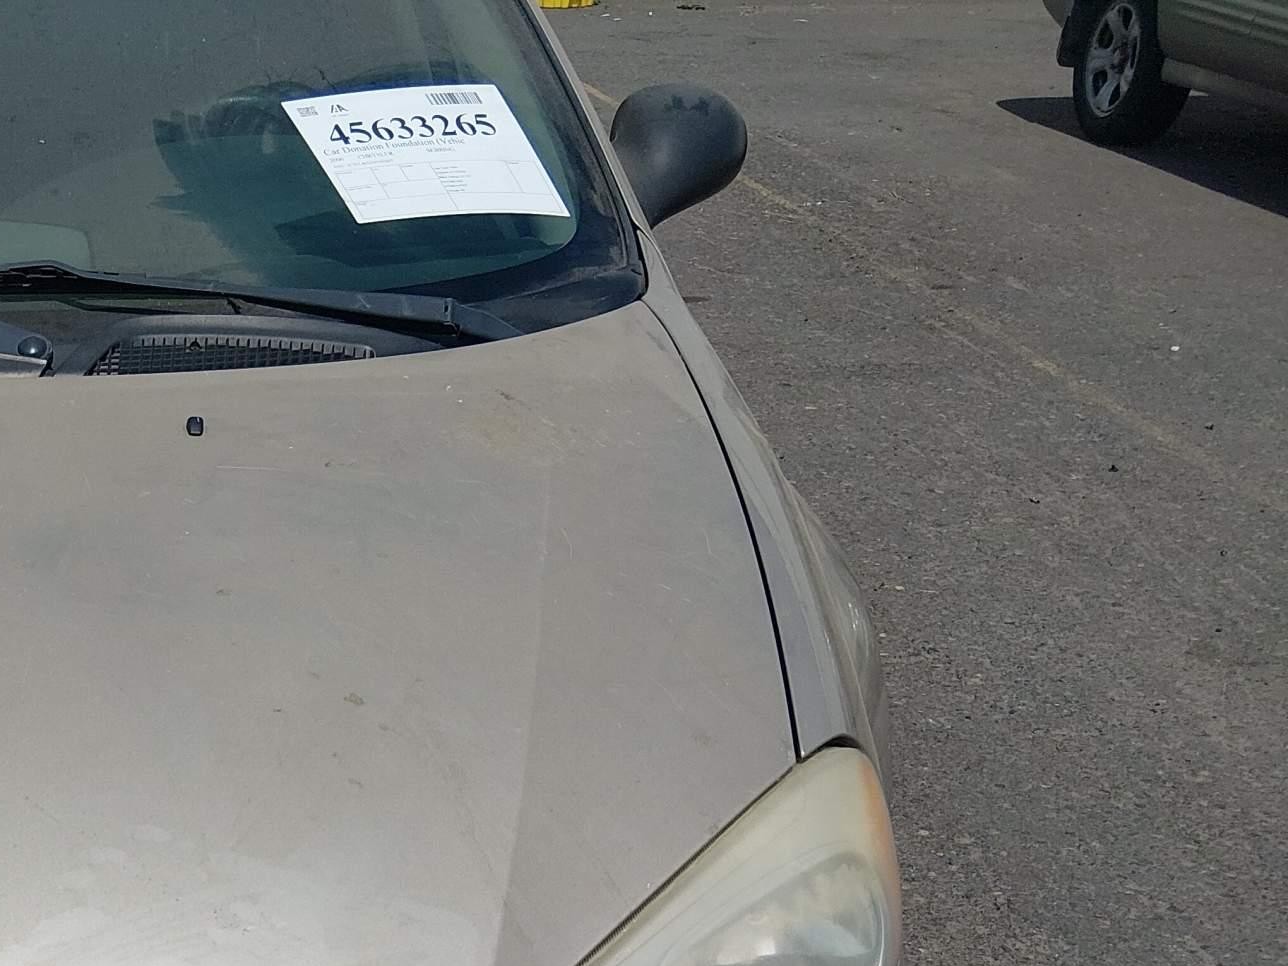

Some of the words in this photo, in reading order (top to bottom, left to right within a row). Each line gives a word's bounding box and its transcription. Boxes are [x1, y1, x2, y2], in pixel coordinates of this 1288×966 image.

[330, 114, 497, 145] 45633265
[323, 148, 340, 156] Car
[341, 144, 384, 154] Donation
[385, 139, 435, 149] Foundation
